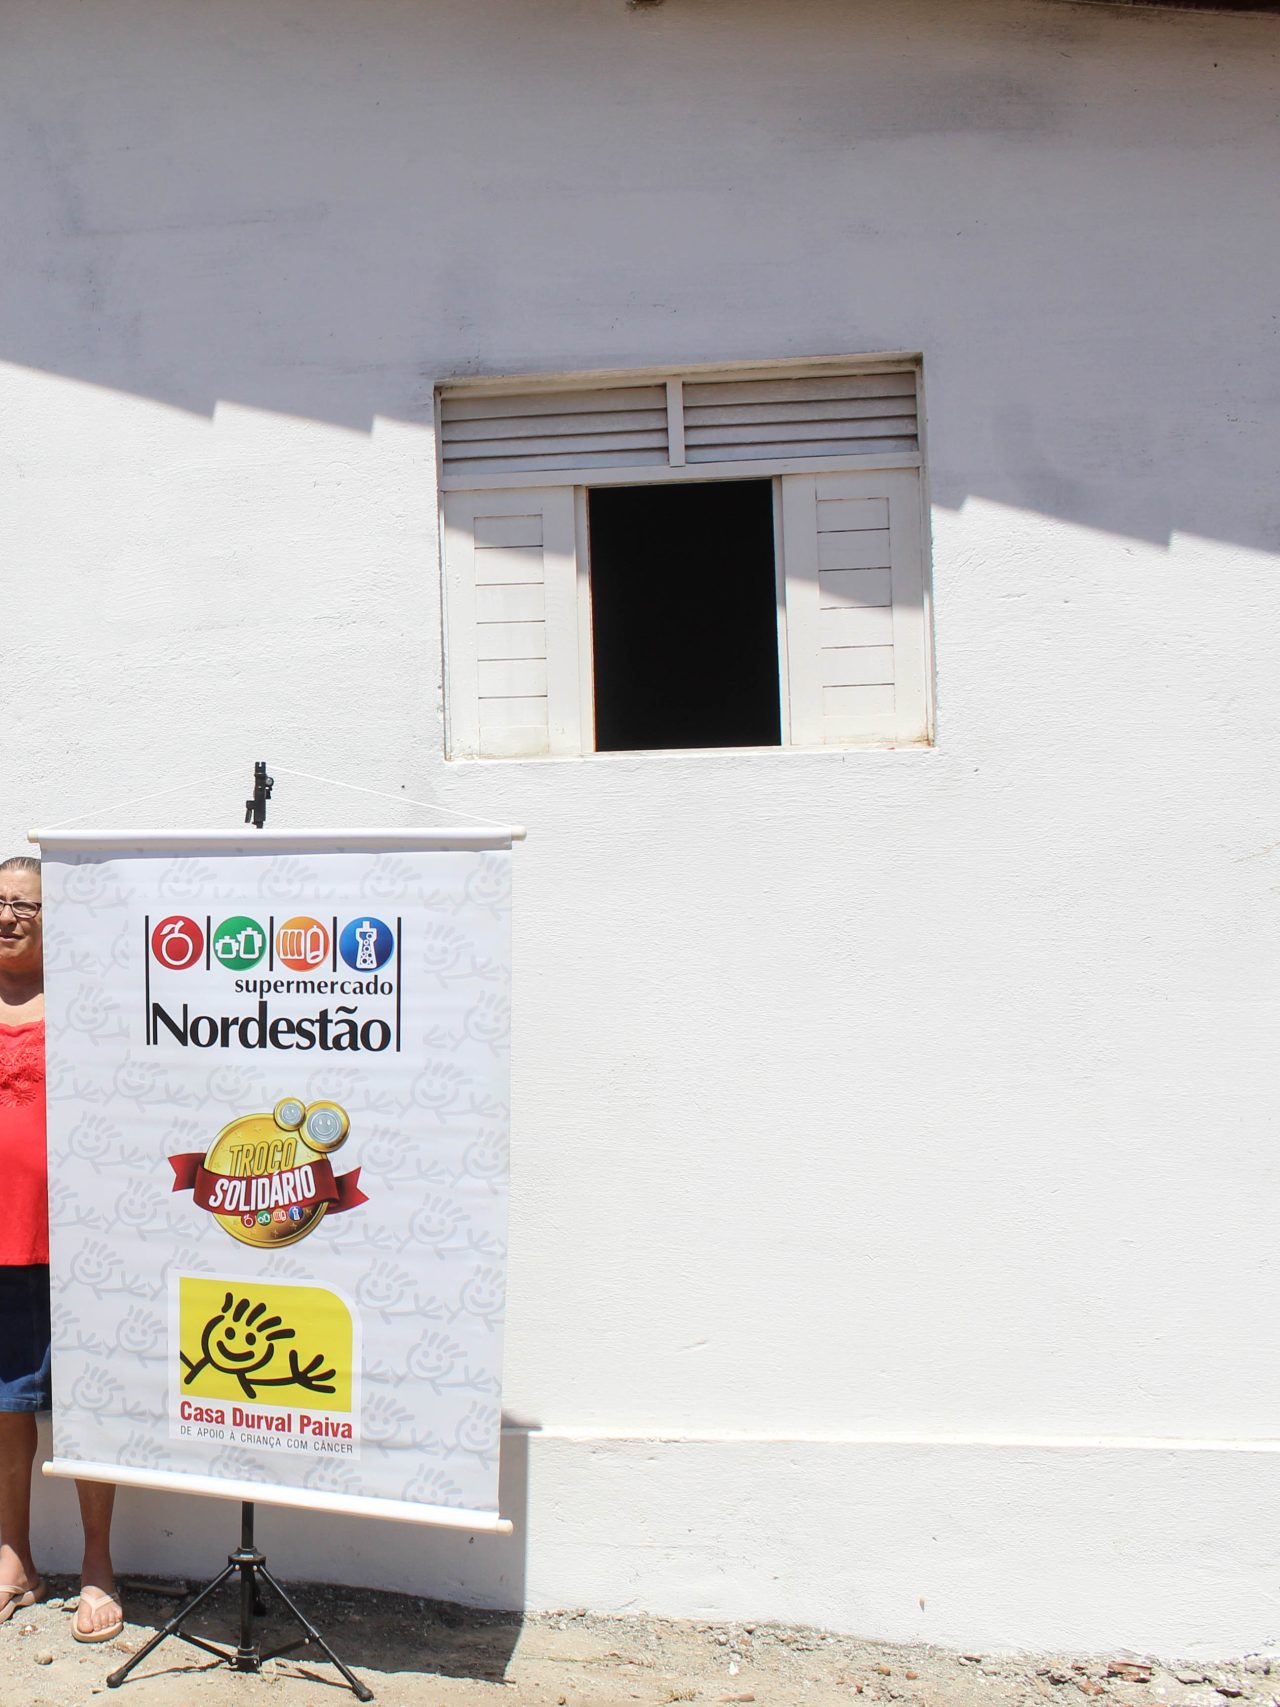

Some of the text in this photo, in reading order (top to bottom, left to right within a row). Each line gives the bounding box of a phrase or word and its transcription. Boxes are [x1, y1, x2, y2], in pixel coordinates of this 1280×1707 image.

[235, 975, 393, 999] supermercado
[152, 1001, 392, 1051] Nordestão
[229, 1138, 297, 1177] TROCO
[209, 1165, 316, 1212] SOLIDÁRIO
[180, 1401, 353, 1439] Casa Durval Paiva
[180, 1425, 192, 1436] DE
[197, 1427, 224, 1440] APOIO
[240, 1433, 282, 1448] CRIANÇA
[287, 1439, 308, 1450] COM
[313, 1440, 353, 1453] CÂNCER
